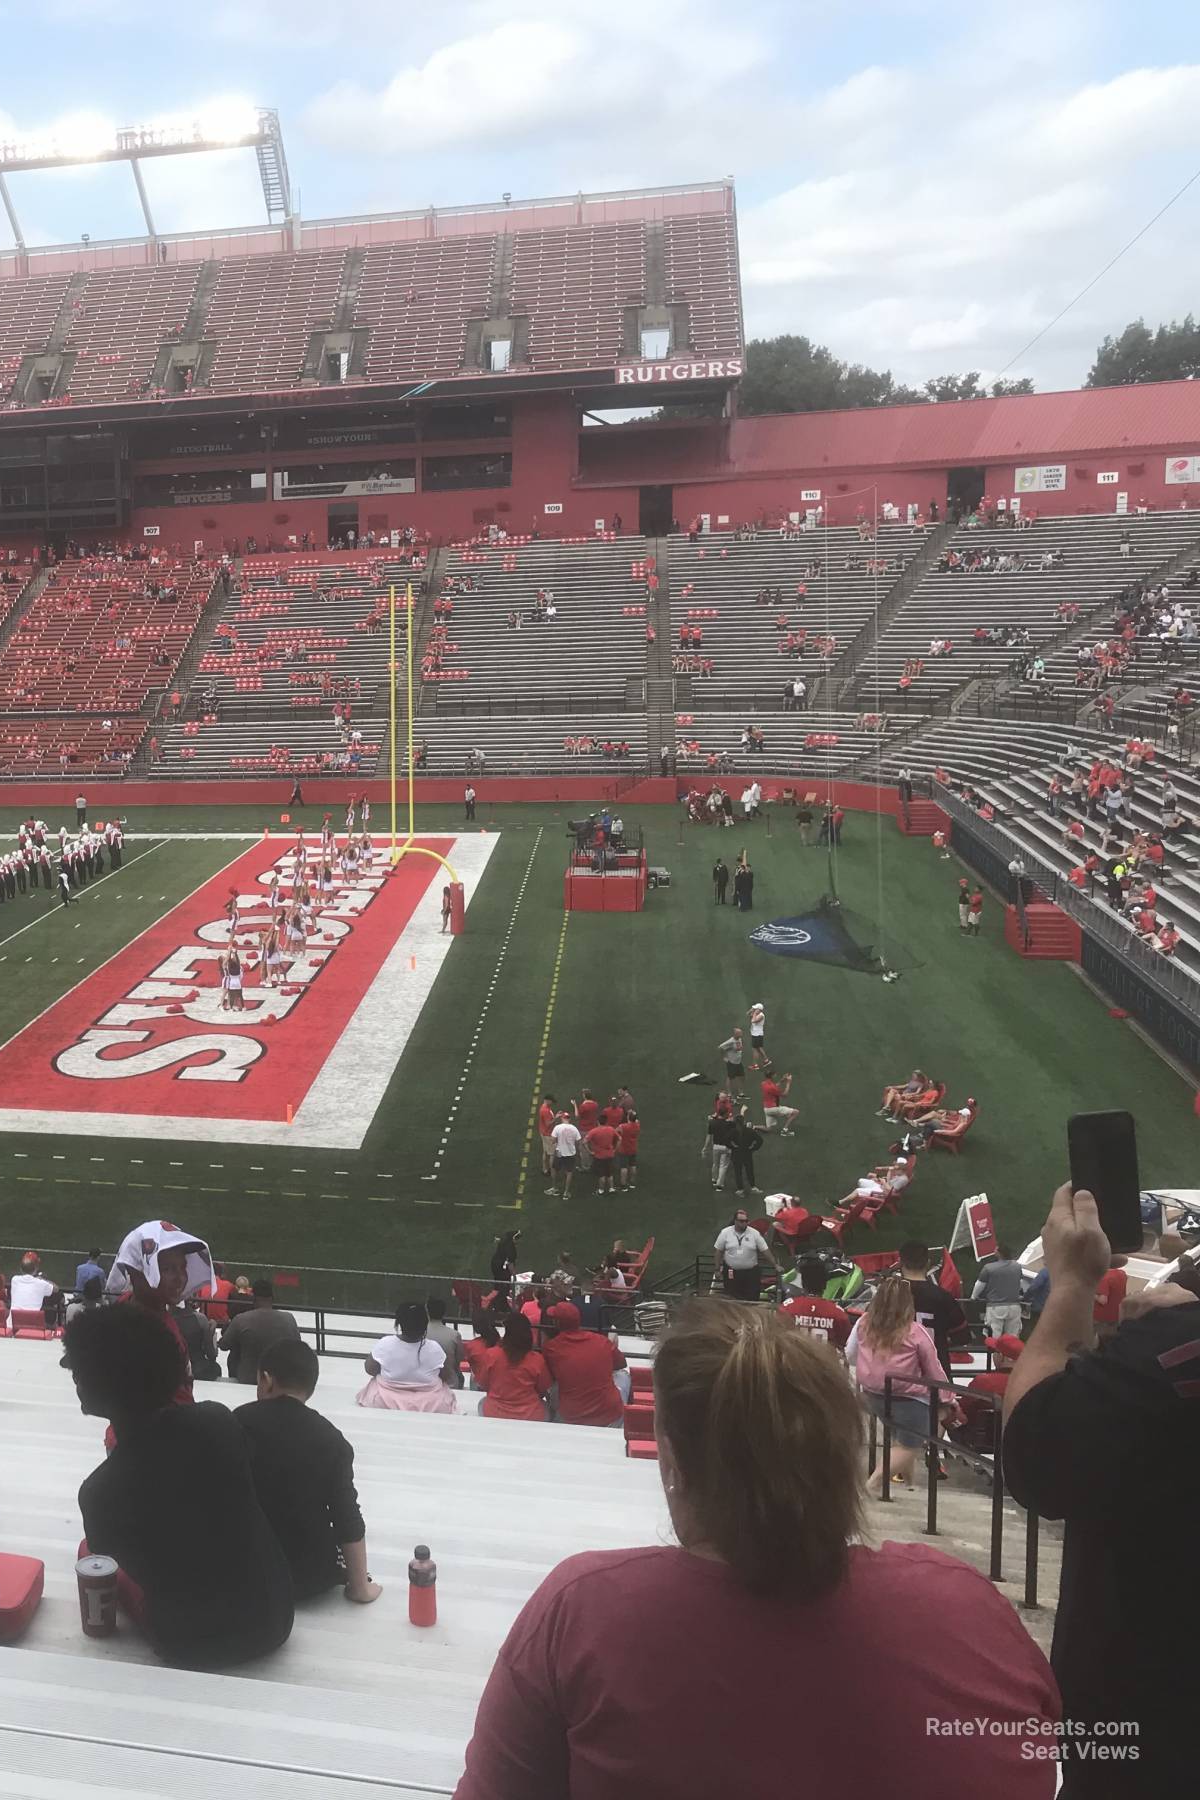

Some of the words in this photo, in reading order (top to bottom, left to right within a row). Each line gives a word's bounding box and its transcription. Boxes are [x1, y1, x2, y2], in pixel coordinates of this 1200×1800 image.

[618, 360, 742, 383] RUTGERS
[804, 492, 818, 500] 110
[546, 505, 560, 513] 109
[795, 1314, 834, 1329] MELTON
